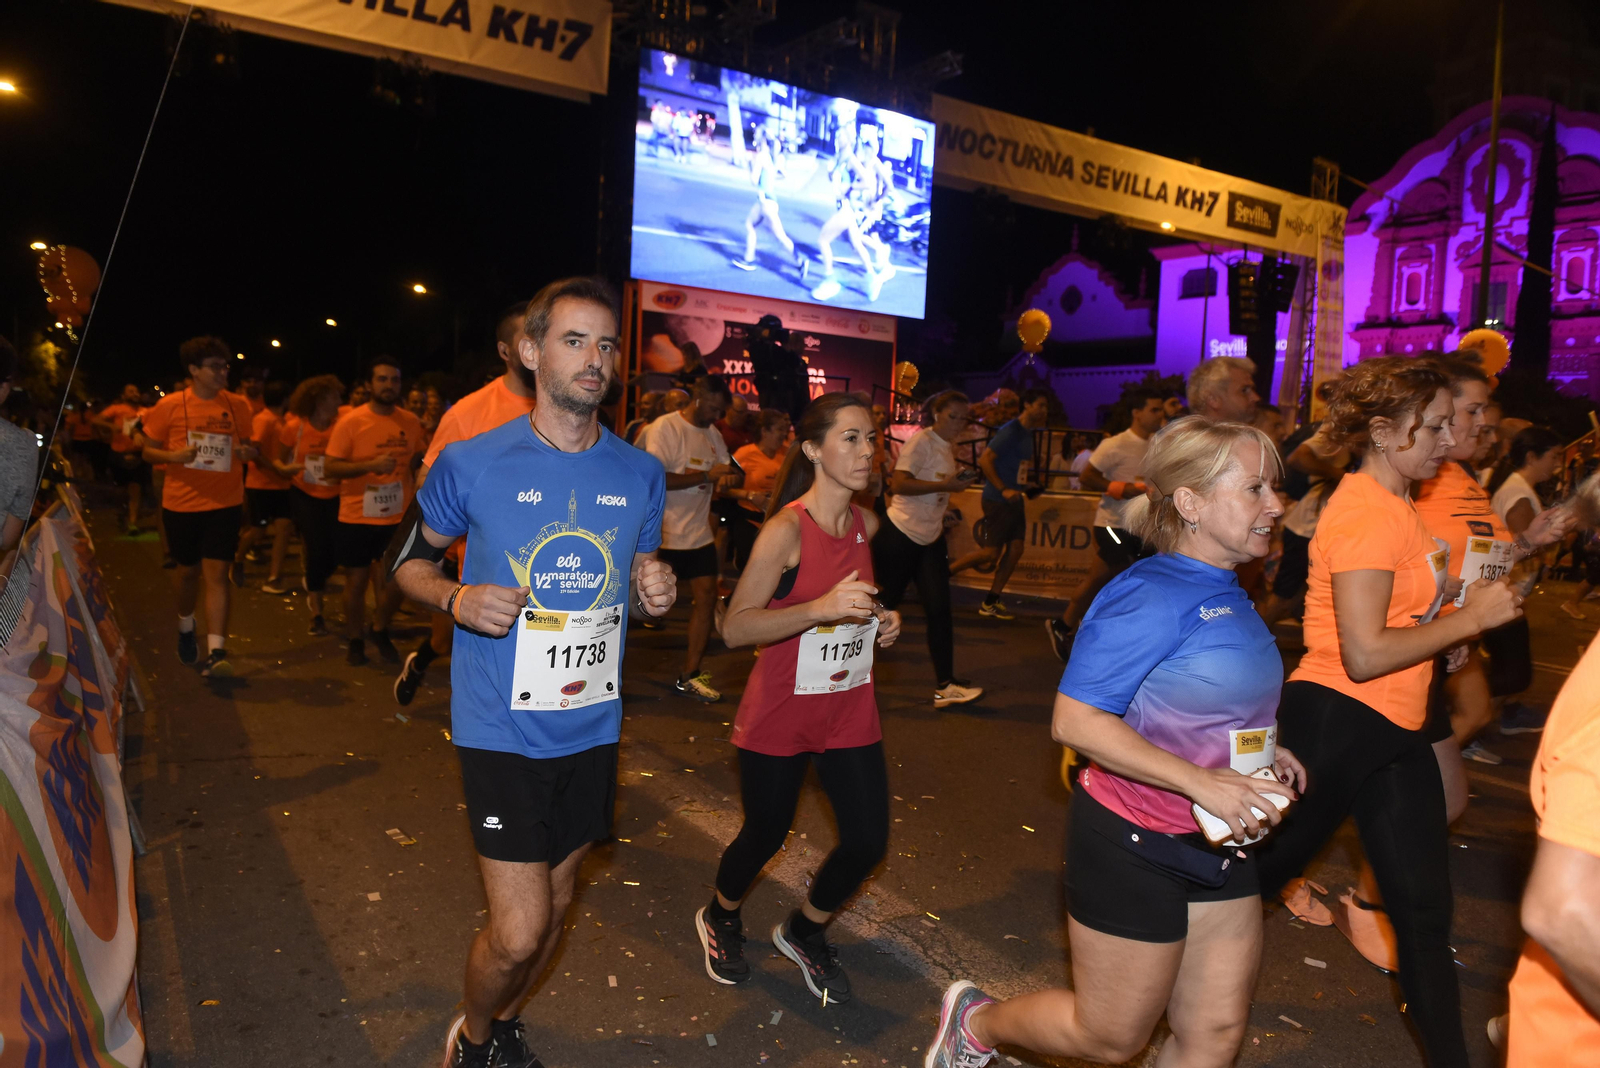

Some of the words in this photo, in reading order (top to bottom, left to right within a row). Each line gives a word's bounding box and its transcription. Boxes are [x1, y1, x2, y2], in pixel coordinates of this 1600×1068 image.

[938, 122, 1074, 180] NOCTURNA
[1080, 160, 1168, 204] SEVILLA
[517, 488, 542, 505] edp
[596, 494, 627, 507] HOKA
[1031, 521, 1091, 550] IMD
[556, 552, 581, 571] edp
[547, 571, 594, 581] maratón
[560, 578, 593, 588] sevilla
[546, 640, 607, 668] 11738
[820, 638, 863, 661] 11739
